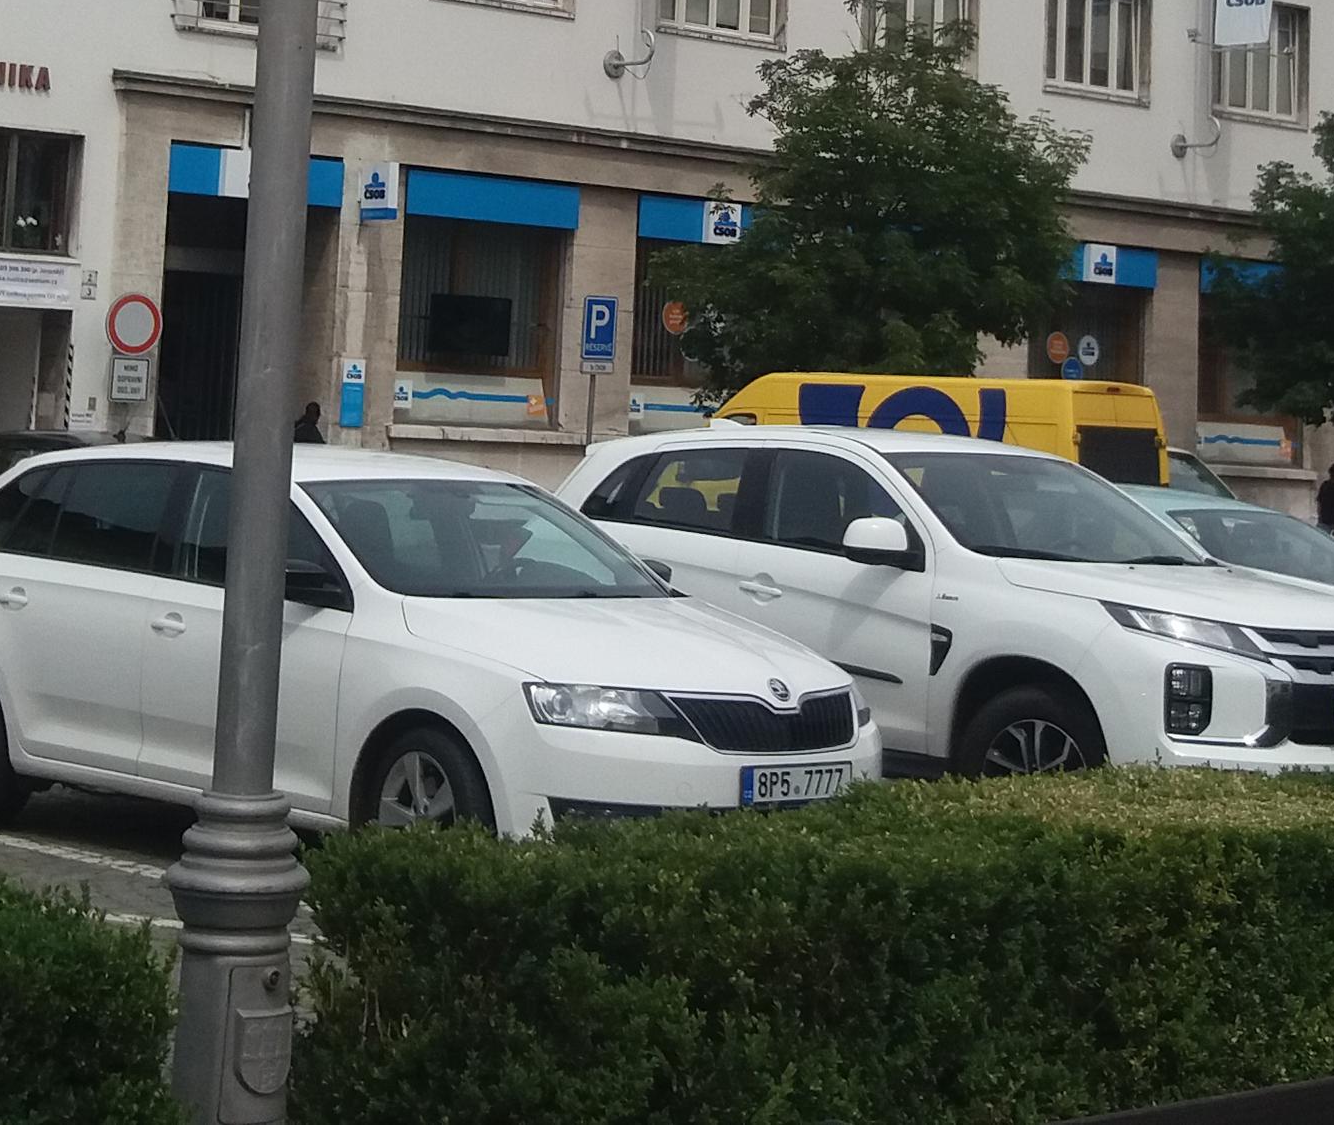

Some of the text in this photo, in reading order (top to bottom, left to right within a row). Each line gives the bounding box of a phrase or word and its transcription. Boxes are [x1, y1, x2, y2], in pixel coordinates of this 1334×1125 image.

[713, 225, 737, 237] ČSOB
[590, 304, 610, 339] P
[757, 767, 845, 799] 8P5 7777
